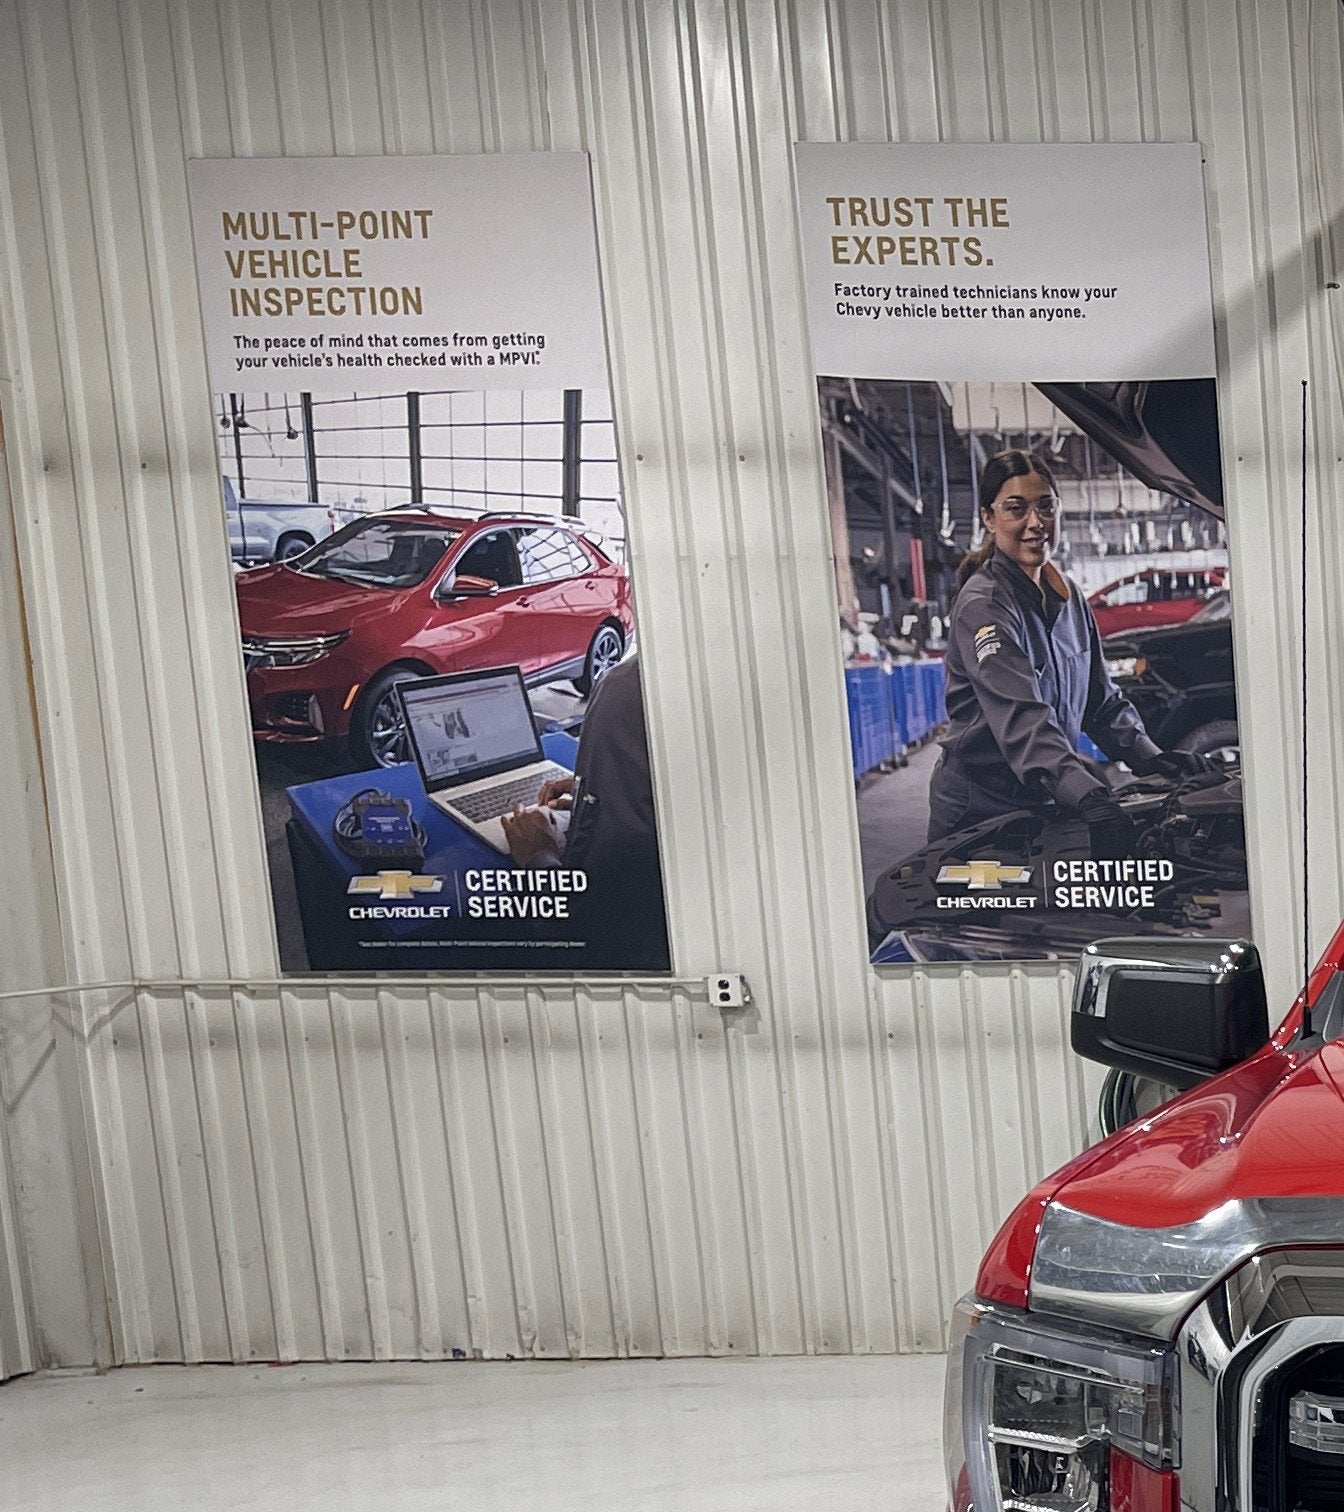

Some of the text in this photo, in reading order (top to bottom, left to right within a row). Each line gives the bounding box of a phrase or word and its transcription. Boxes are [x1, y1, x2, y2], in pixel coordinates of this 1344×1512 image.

[826, 197, 1010, 228] TRUST THE
[221, 209, 433, 241] MULTI-POINT
[830, 236, 994, 266] EXPERTS.
[225, 249, 363, 279] VEHICLE
[230, 287, 424, 317] INSPECTION
[834, 283, 1118, 301] Factory trained technicians know your
[836, 302, 1086, 322] Chevy vehicle better than anyone.
[233, 331, 546, 352] The peace of mind that comes from getting
[235, 356, 268, 371] your
[272, 353, 333, 368] vehicle's
[337, 352, 383, 367] health
[386, 352, 447, 367] checked
[450, 351, 483, 366] with
[487, 355, 495, 366] a
[465, 869, 588, 893] CERTIFIED
[1053, 859, 1174, 883] CERTIFIED
[468, 896, 570, 918] SERVICE
[936, 896, 1038, 909] CHEVROLET
[1054, 886, 1155, 908] SERVICE
[348, 905, 451, 920] CHEVROLET
